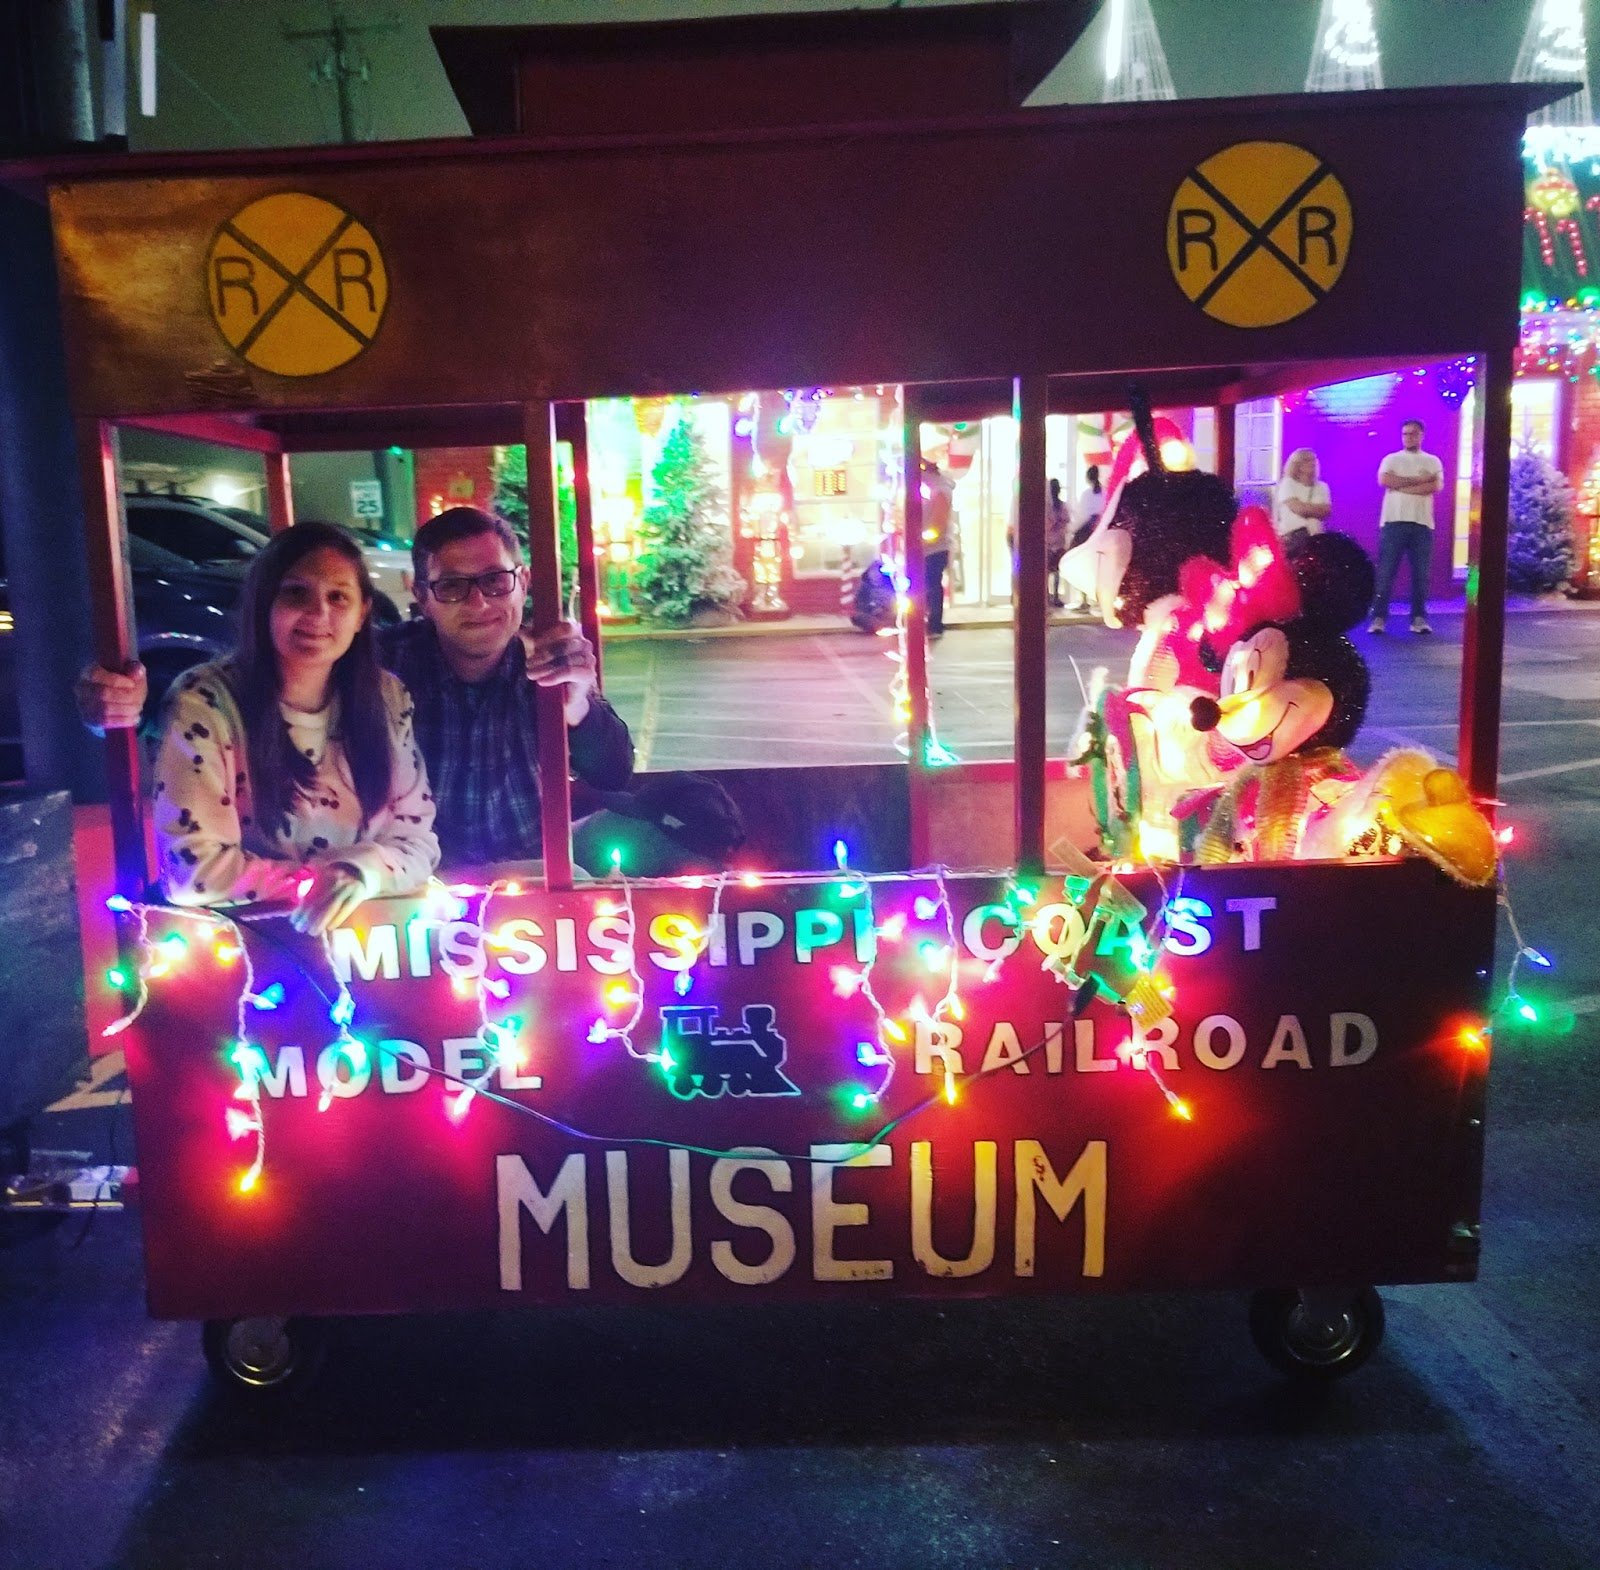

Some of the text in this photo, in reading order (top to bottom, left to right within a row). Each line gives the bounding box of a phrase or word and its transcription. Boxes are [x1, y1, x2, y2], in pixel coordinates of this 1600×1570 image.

[357, 500, 379, 514] 25
[334, 897, 1277, 982] MISSISSIPPI COAST
[243, 1011, 1379, 1100] MODEL RAILROAD
[496, 1140, 1108, 1291] MUSEUM
